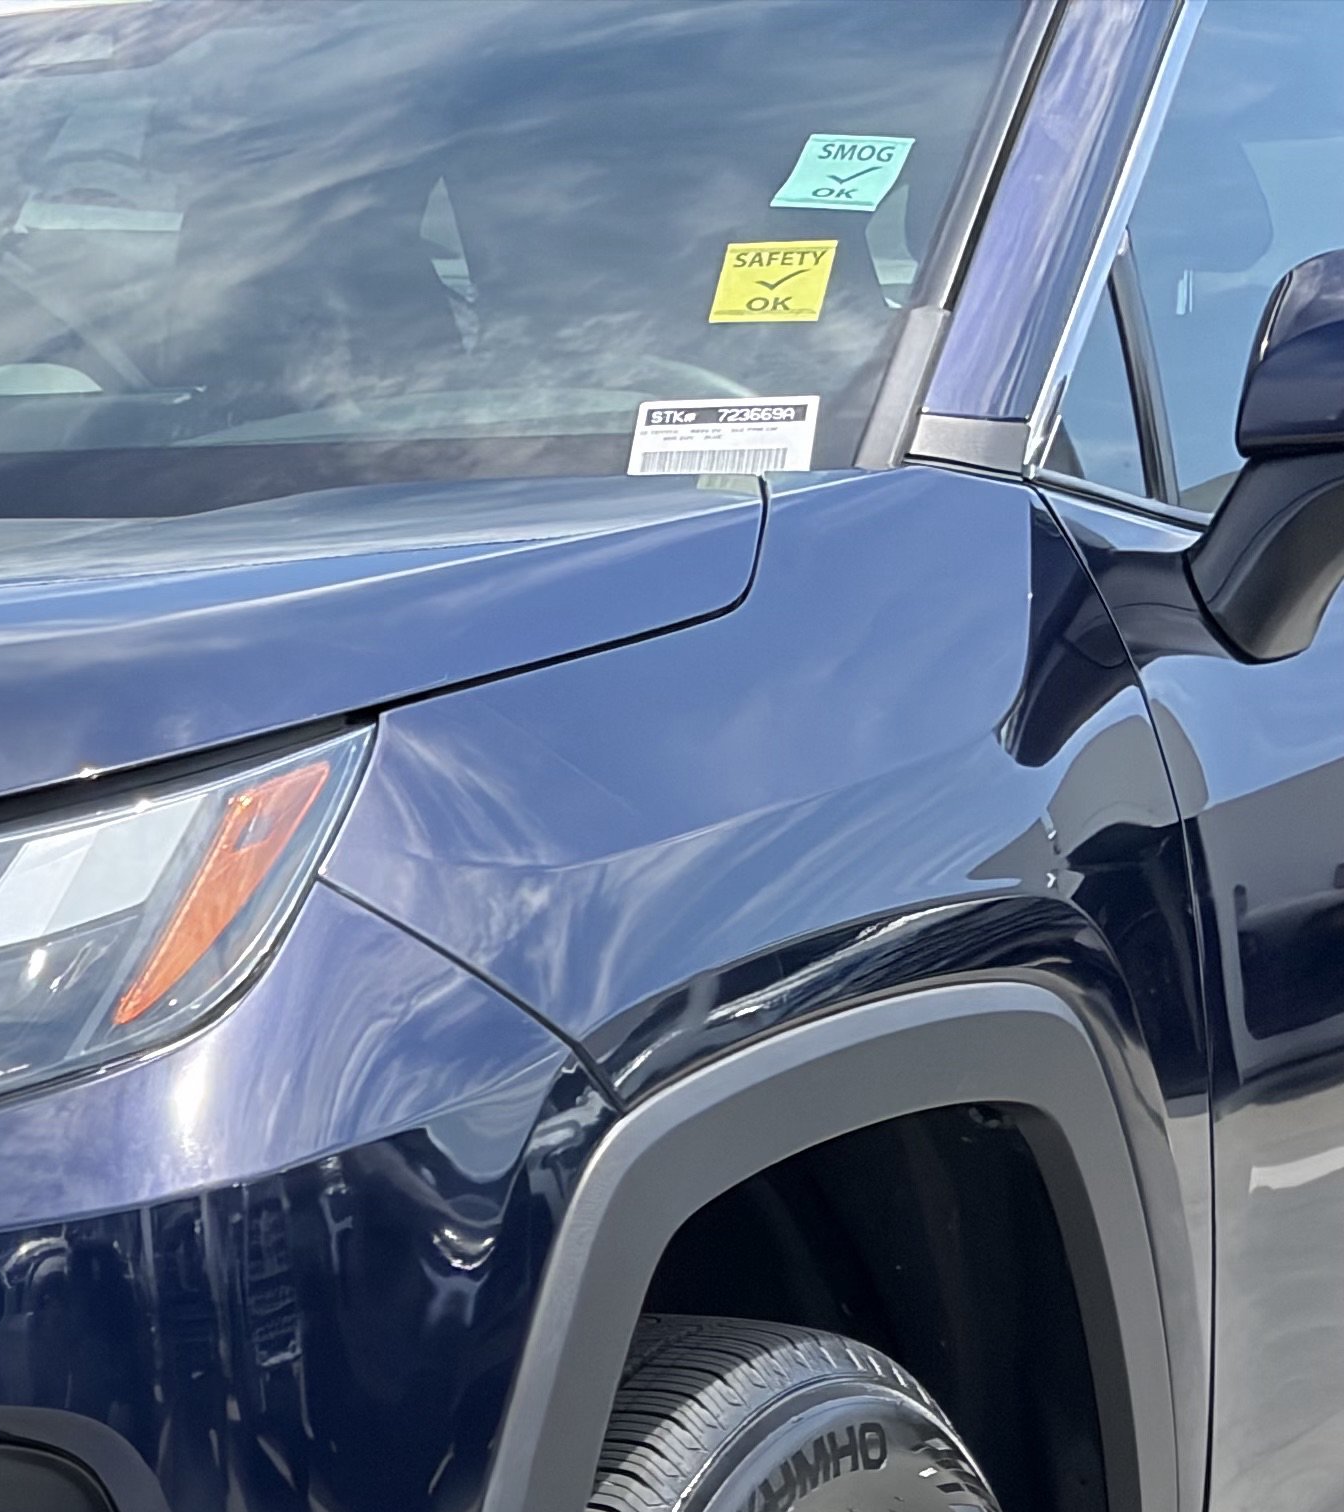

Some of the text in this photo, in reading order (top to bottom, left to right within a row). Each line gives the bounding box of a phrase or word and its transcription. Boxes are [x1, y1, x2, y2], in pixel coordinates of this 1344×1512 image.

[817, 143, 896, 163] SMOG
[811, 187, 860, 200] OK
[732, 250, 828, 268] SAFETY
[745, 296, 794, 312] OK
[717, 407, 796, 423] 723669A
